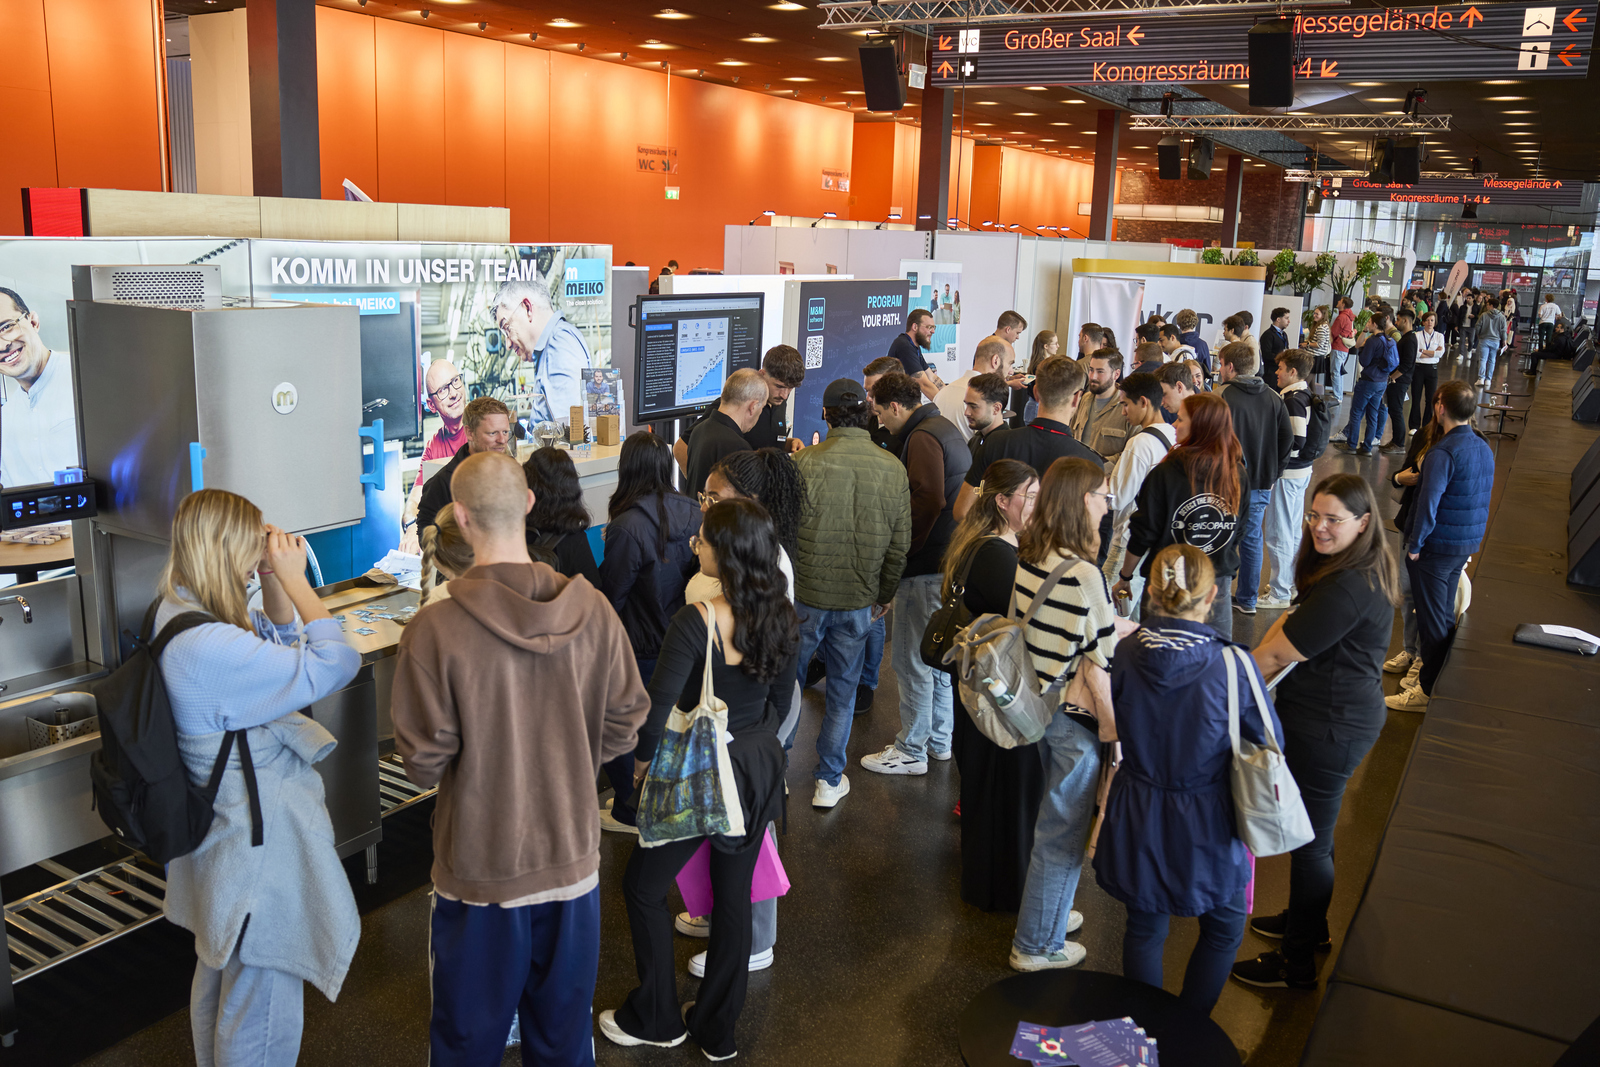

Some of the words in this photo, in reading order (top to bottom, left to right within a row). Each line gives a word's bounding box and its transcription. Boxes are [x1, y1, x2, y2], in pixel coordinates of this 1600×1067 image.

[1004, 28, 1074, 50] Großer
[1080, 25, 1121, 48] Saal
[1092, 60, 1250, 82] Kongressräum
[1297, 57, 1313, 78] 4
[638, 159, 655, 170] WC
[1483, 179, 1551, 190] Messegelände
[1390, 193, 1459, 203] Kongressräume
[1474, 195, 1480, 203] 4
[271, 257, 357, 284] KOMM
[366, 258, 390, 284] IN
[398, 258, 475, 283] UNSER
[480, 258, 537, 282] TEAM
[566, 282, 604, 296] MEIKO
[356, 297, 396, 310] MEIKO
[867, 294, 903, 309] PROGRAM
[809, 306, 824, 315] M&M
[861, 314, 881, 328] YOUR
[882, 313, 901, 326] PATH.
[1178, 501, 1197, 517] DETECT
[1196, 497, 1207, 505] THE
